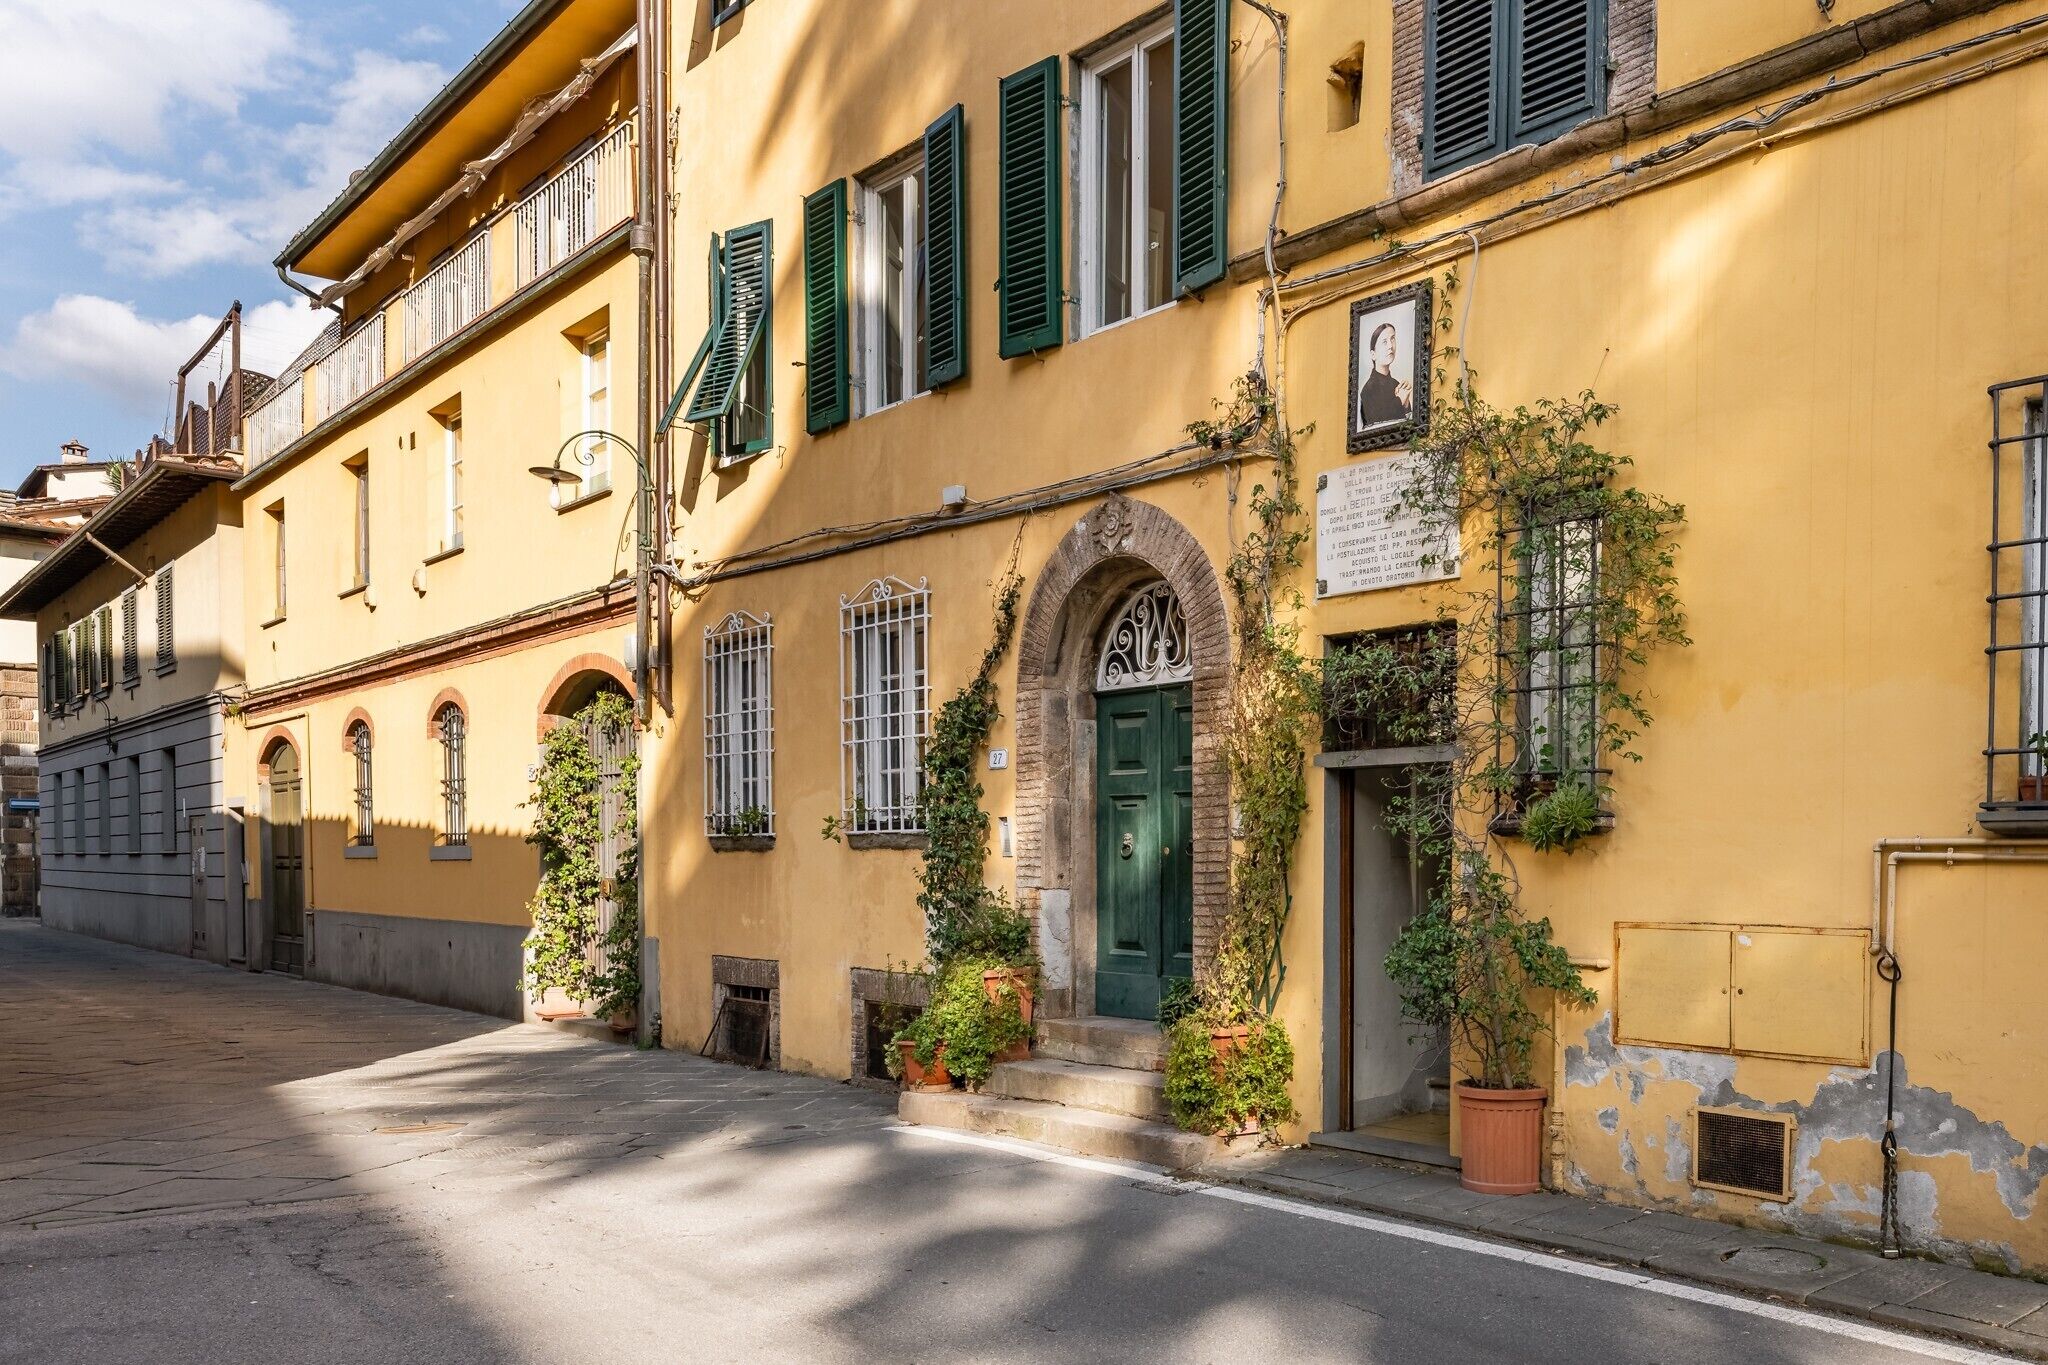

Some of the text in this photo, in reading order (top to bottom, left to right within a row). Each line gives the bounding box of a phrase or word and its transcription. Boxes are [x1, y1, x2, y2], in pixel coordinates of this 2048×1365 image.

[1366, 473, 1383, 483] PARTE
[1355, 486, 1372, 496] TROVA
[1320, 507, 1336, 516] DONDE
[1350, 496, 1376, 510] BEATA
[1330, 515, 1343, 524] DOPO
[1347, 511, 1363, 520] AVERE
[1332, 524, 1350, 533] APRILE
[1338, 536, 1376, 548] CONSERVARNE
[1391, 530, 1406, 538] CARA
[1337, 546, 1375, 559] POSTULAZIONE
[1393, 541, 1402, 549] PP.
[1391, 550, 1414, 560] LOCALE
[1361, 576, 1382, 585] DEVOTO
[1386, 571, 1414, 581] ORATORIO
[993, 753, 1002, 764] 27
